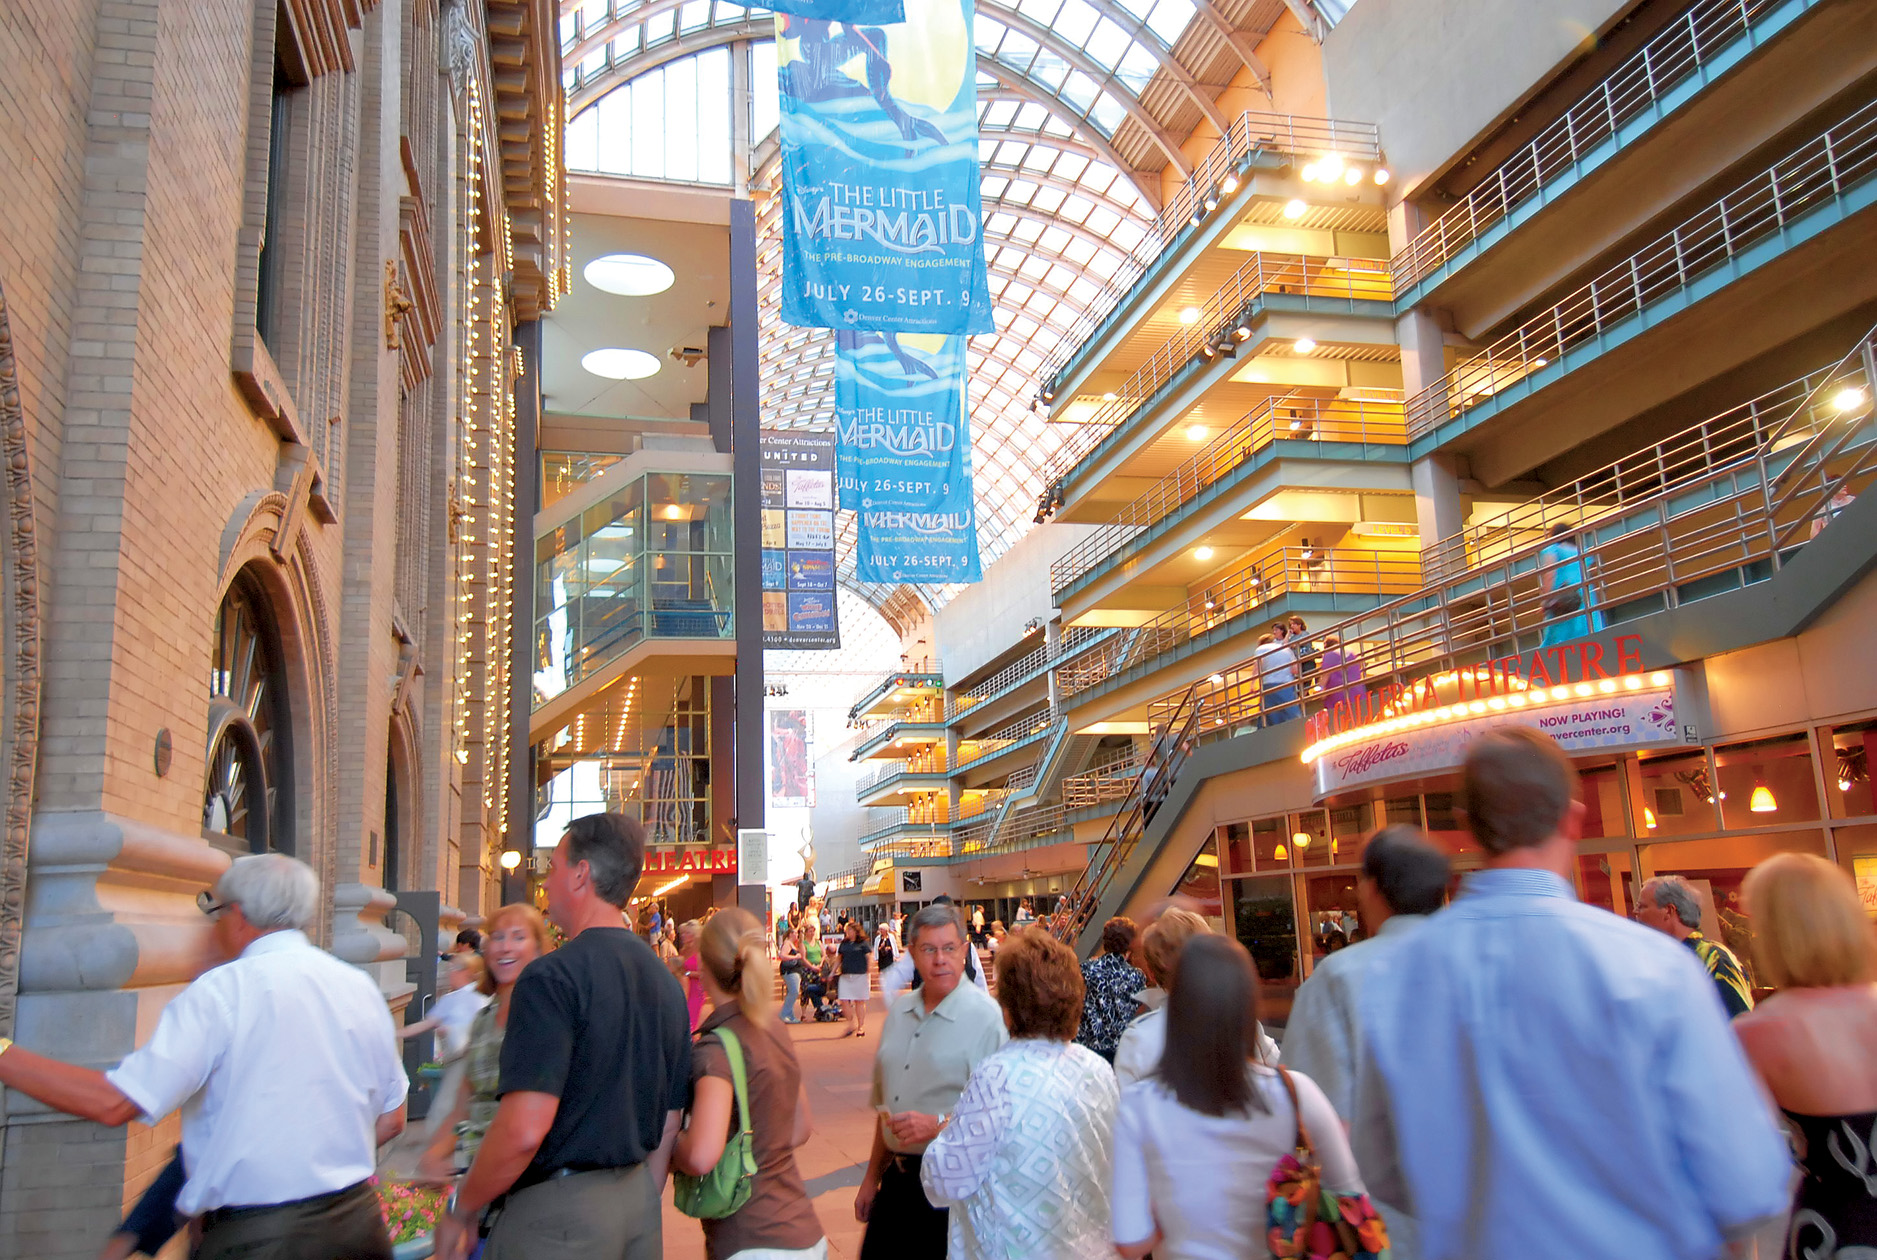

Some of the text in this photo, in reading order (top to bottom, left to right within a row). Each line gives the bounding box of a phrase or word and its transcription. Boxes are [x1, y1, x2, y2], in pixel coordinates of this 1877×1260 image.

[829, 182, 946, 211] THE LITTLE
[794, 194, 977, 256] MERMAID
[804, 251, 971, 268] THE PRE-BROADWAY ENGAGEMENT
[804, 281, 970, 307] JULY 26-SEPT. 9
[858, 313, 938, 325] Denver Center Attractions
[857, 407, 934, 426] THE LITTLE
[768, 437, 791, 445] Center
[793, 438, 831, 447] Attractions
[835, 415, 955, 459] MERMAID
[905, 460, 951, 468] ENGAGEMENT
[838, 477, 949, 495] JULY 26-SEPT. 9
[1373, 525, 1403, 534] LEVEL
[870, 555, 968, 567] JULY 26-SEPT. 9
[1449, 633, 1645, 702] THEATRE
[1539, 707, 1626, 728] NOW PLAYING!
[1550, 724, 1631, 740] nvercenter.org
[1337, 741, 1409, 780] Taffetas
[645, 849, 737, 872] HEATRE
